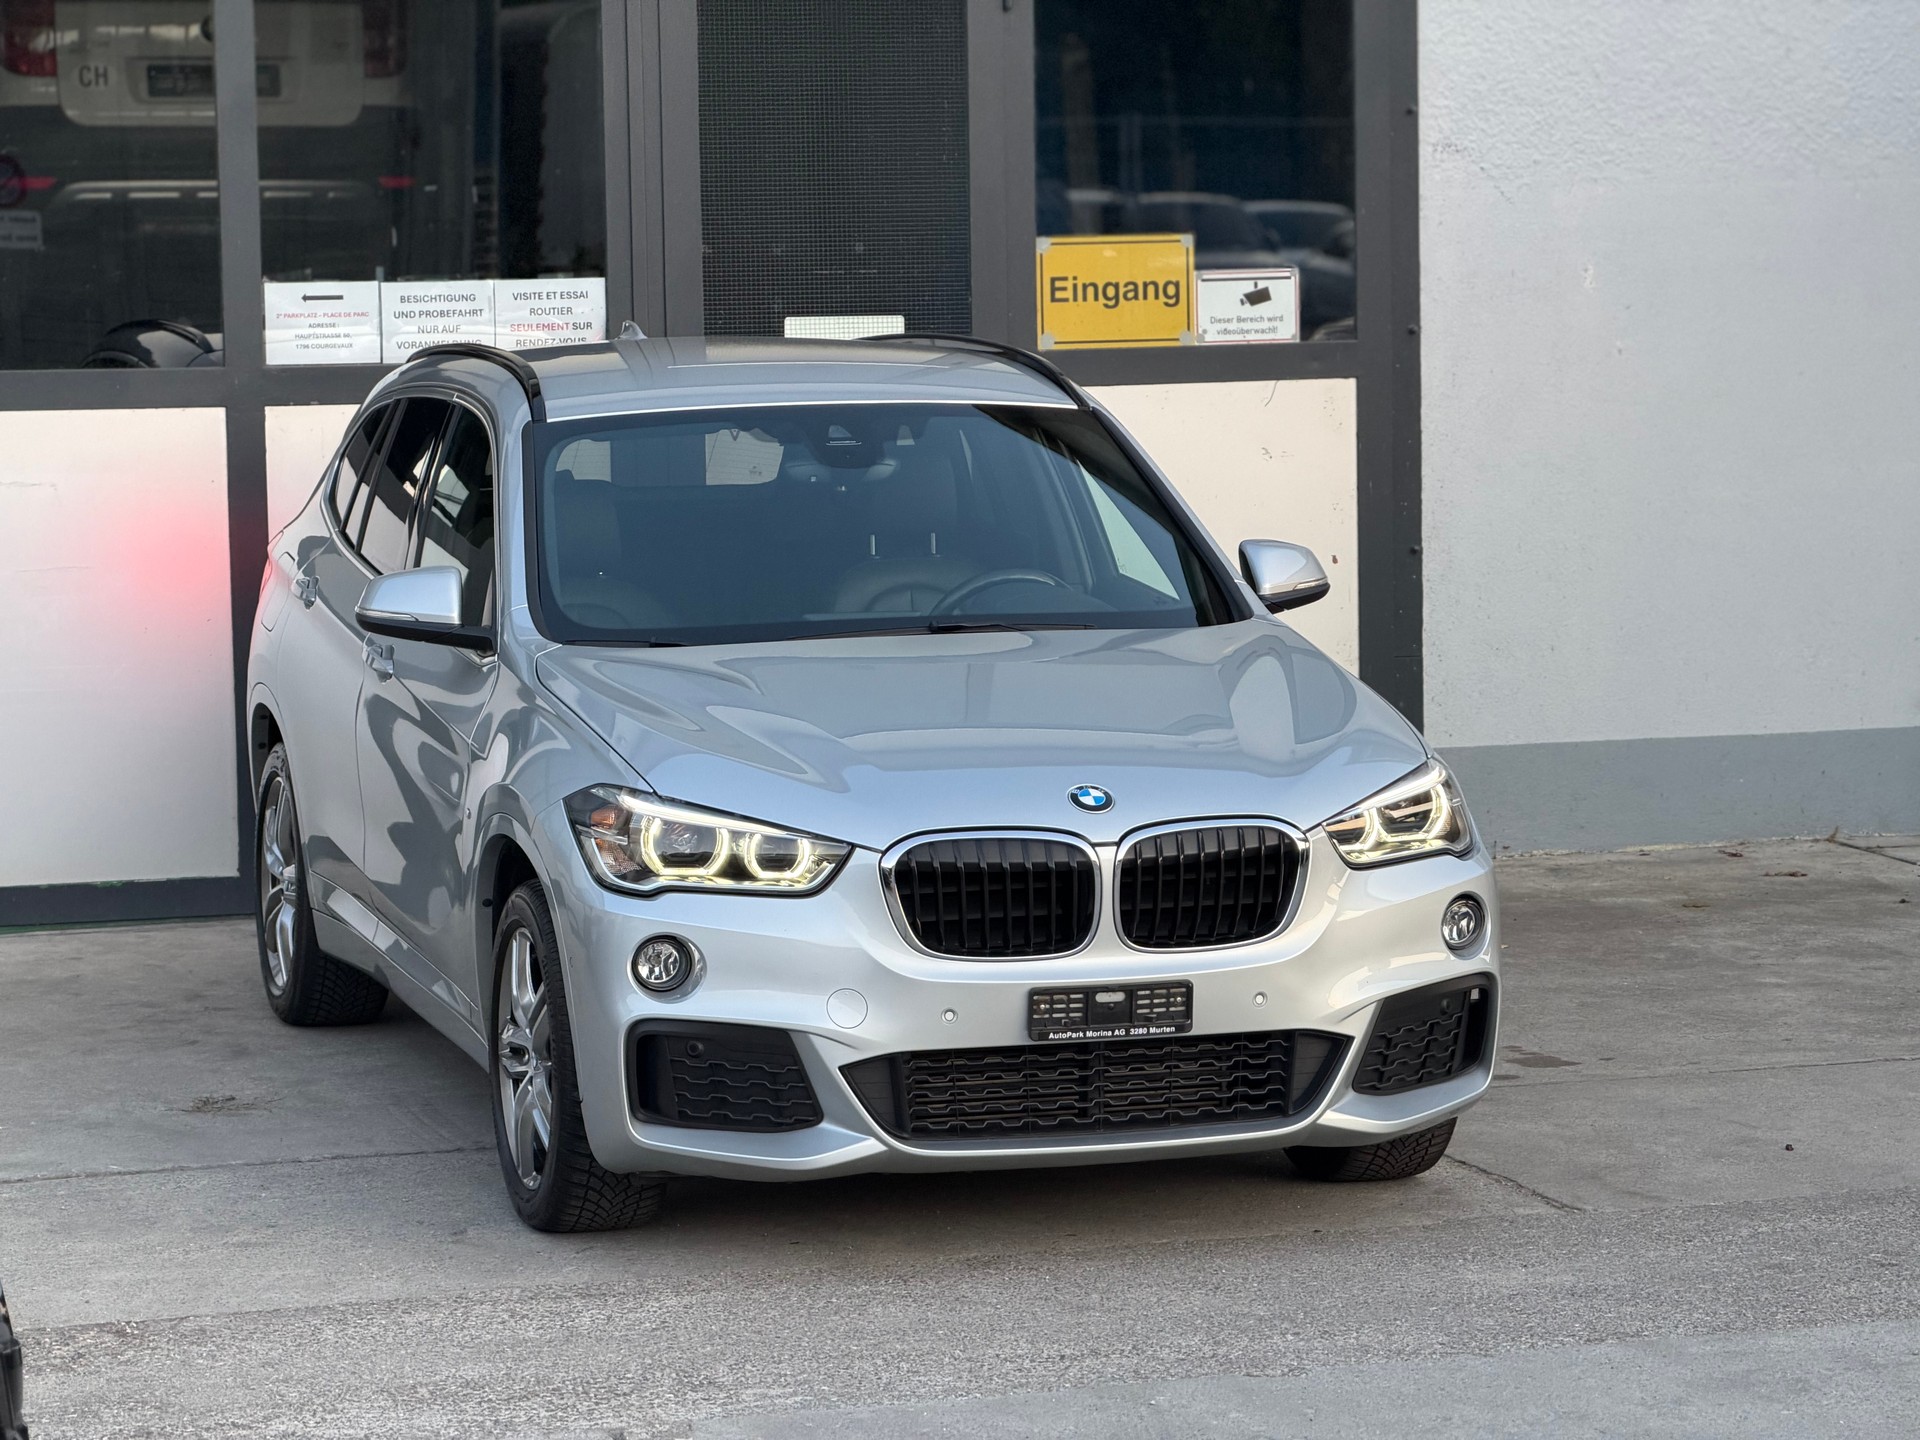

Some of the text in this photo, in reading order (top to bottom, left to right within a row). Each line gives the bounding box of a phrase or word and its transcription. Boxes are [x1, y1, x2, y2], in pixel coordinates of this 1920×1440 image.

[78, 64, 109, 88] CH
[512, 290, 589, 301] VISITE ET ESSAI
[1049, 275, 1181, 309] Eingang
[399, 293, 477, 304] BESICHTIGUNG
[393, 308, 484, 319] UND PROBEFAHRT
[529, 306, 573, 316] ROUTIER
[1209, 314, 1284, 324] Dieser Bereich wird
[417, 324, 461, 334] NUR AUF
[510, 321, 593, 332] SEULEMENT SUR
[1216, 326, 1278, 335] videoüberwacht!
[1048, 1026, 1176, 1039] AutoPark Morina AG 3280 Murten
